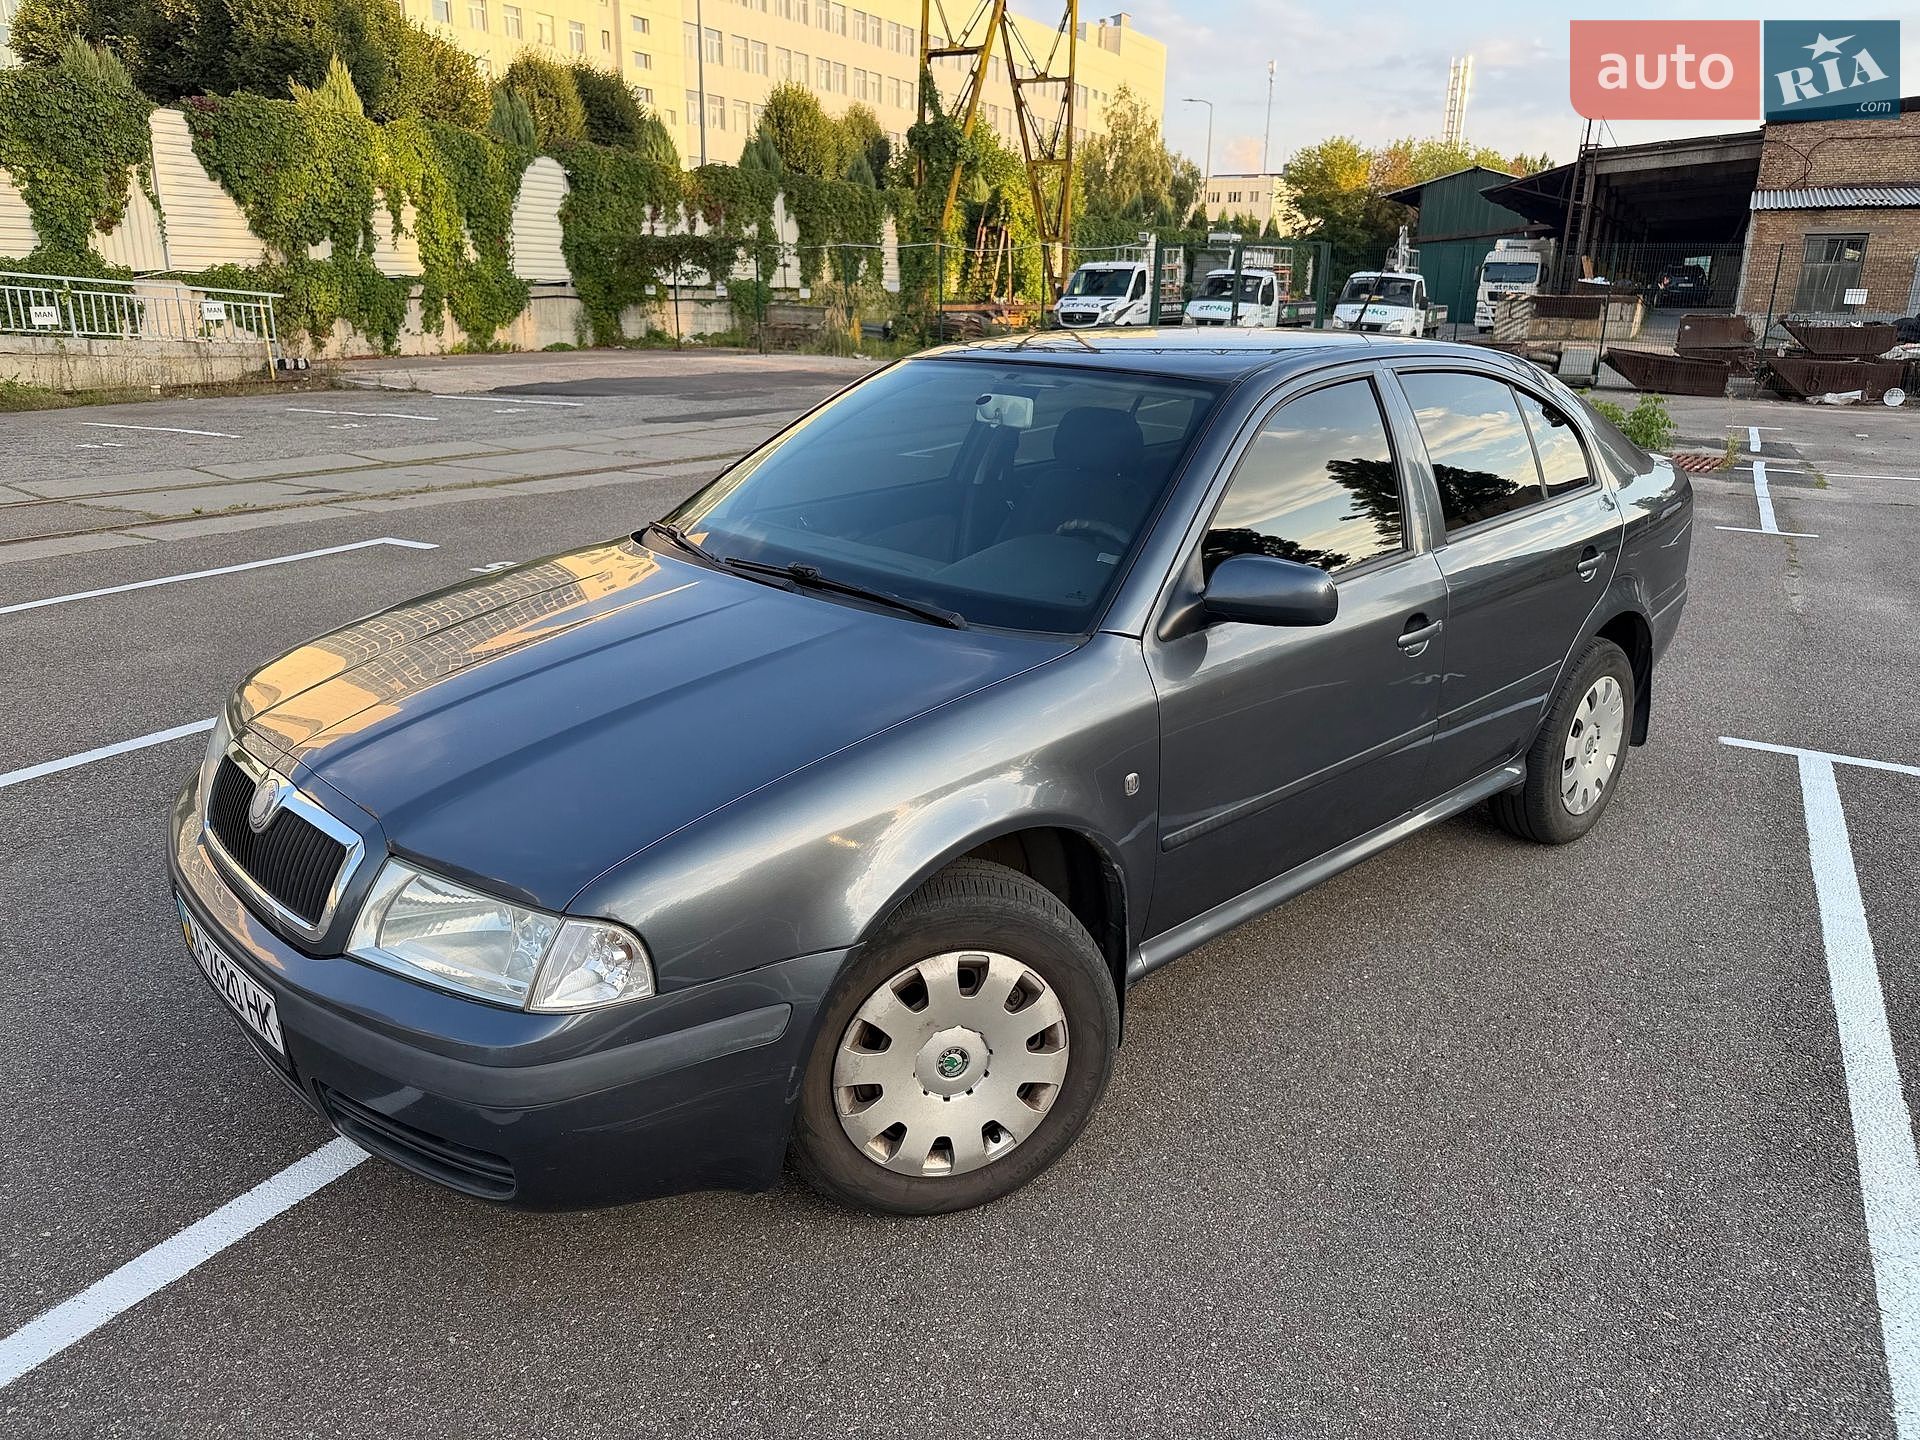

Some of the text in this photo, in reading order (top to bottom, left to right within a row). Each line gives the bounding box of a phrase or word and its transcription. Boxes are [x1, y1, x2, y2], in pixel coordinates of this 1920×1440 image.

[34, 311, 54, 320] MAN
[206, 307, 223, 315] MAN
[205, 941, 245, 1012] 2620
[243, 979, 280, 1046] HK
